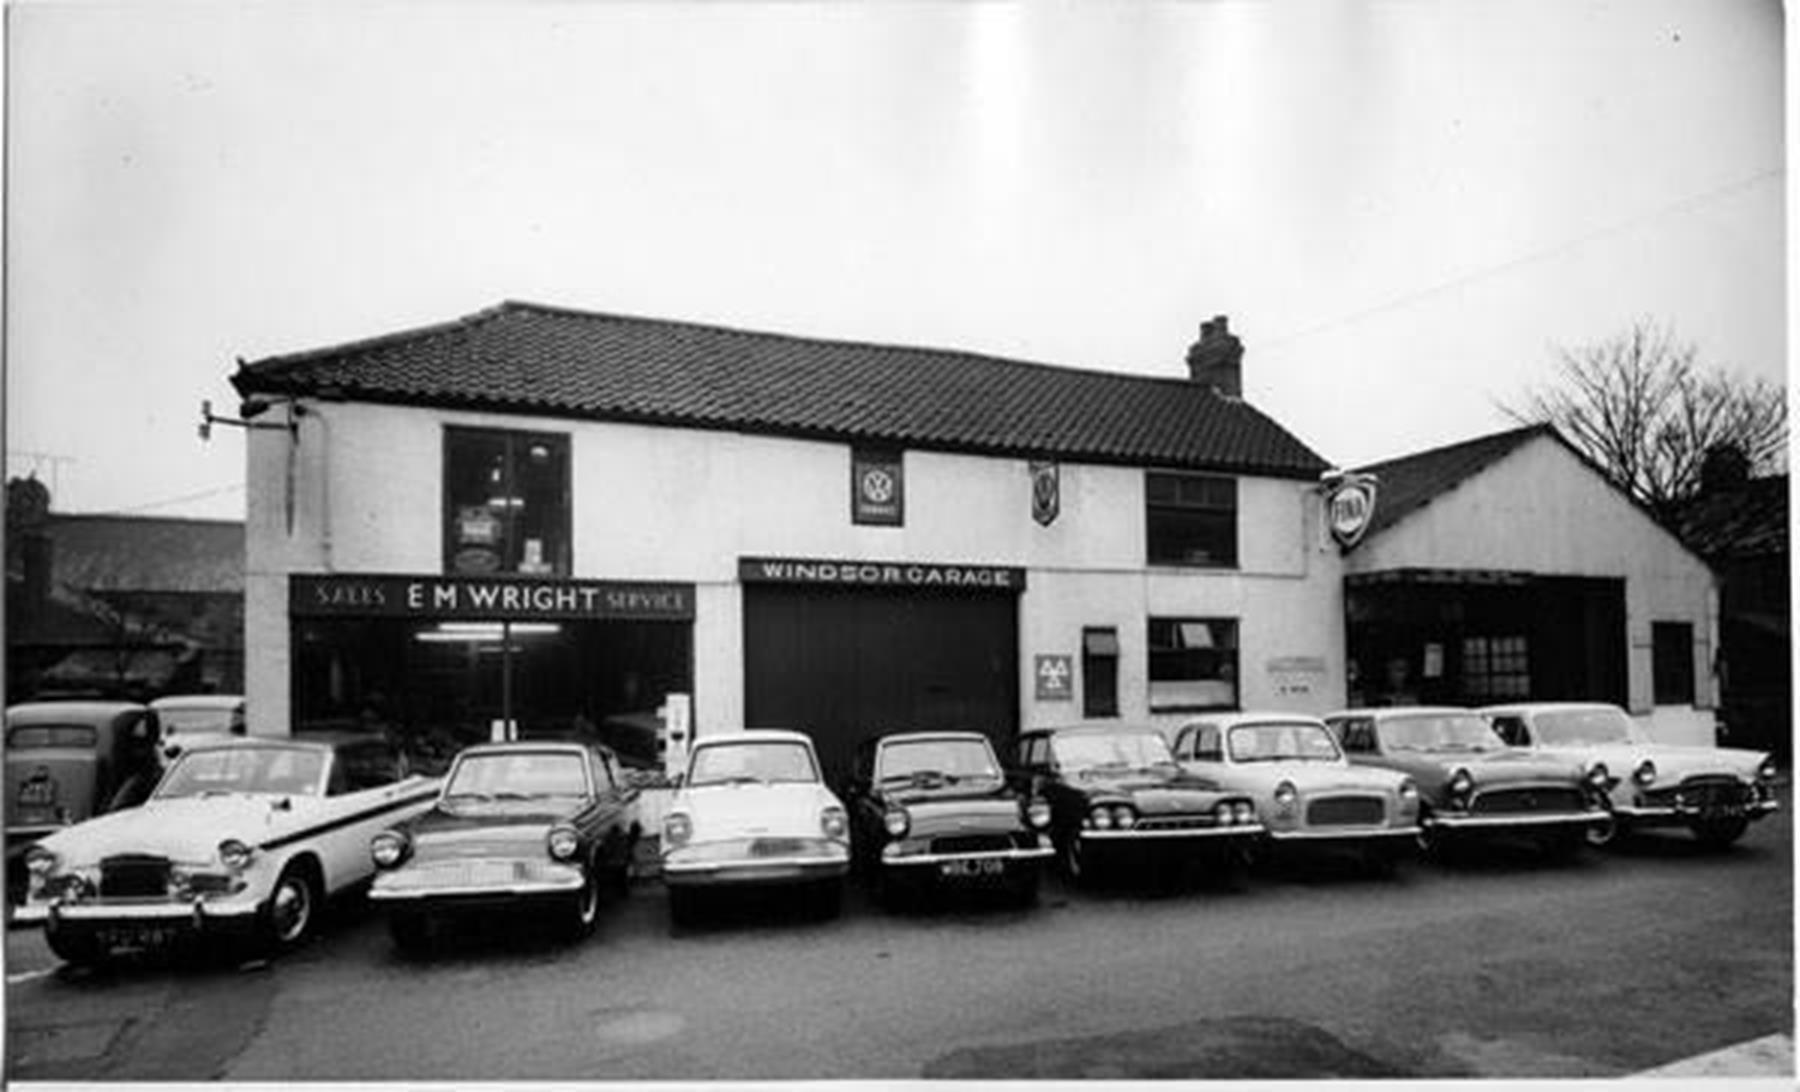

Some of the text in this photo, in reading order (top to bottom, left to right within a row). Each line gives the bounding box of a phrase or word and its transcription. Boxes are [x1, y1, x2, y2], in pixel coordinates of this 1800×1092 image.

[762, 562, 1010, 587] WINDSOR GARAGE
[315, 583, 684, 610] SALES E M WRIGHT SERVICE
